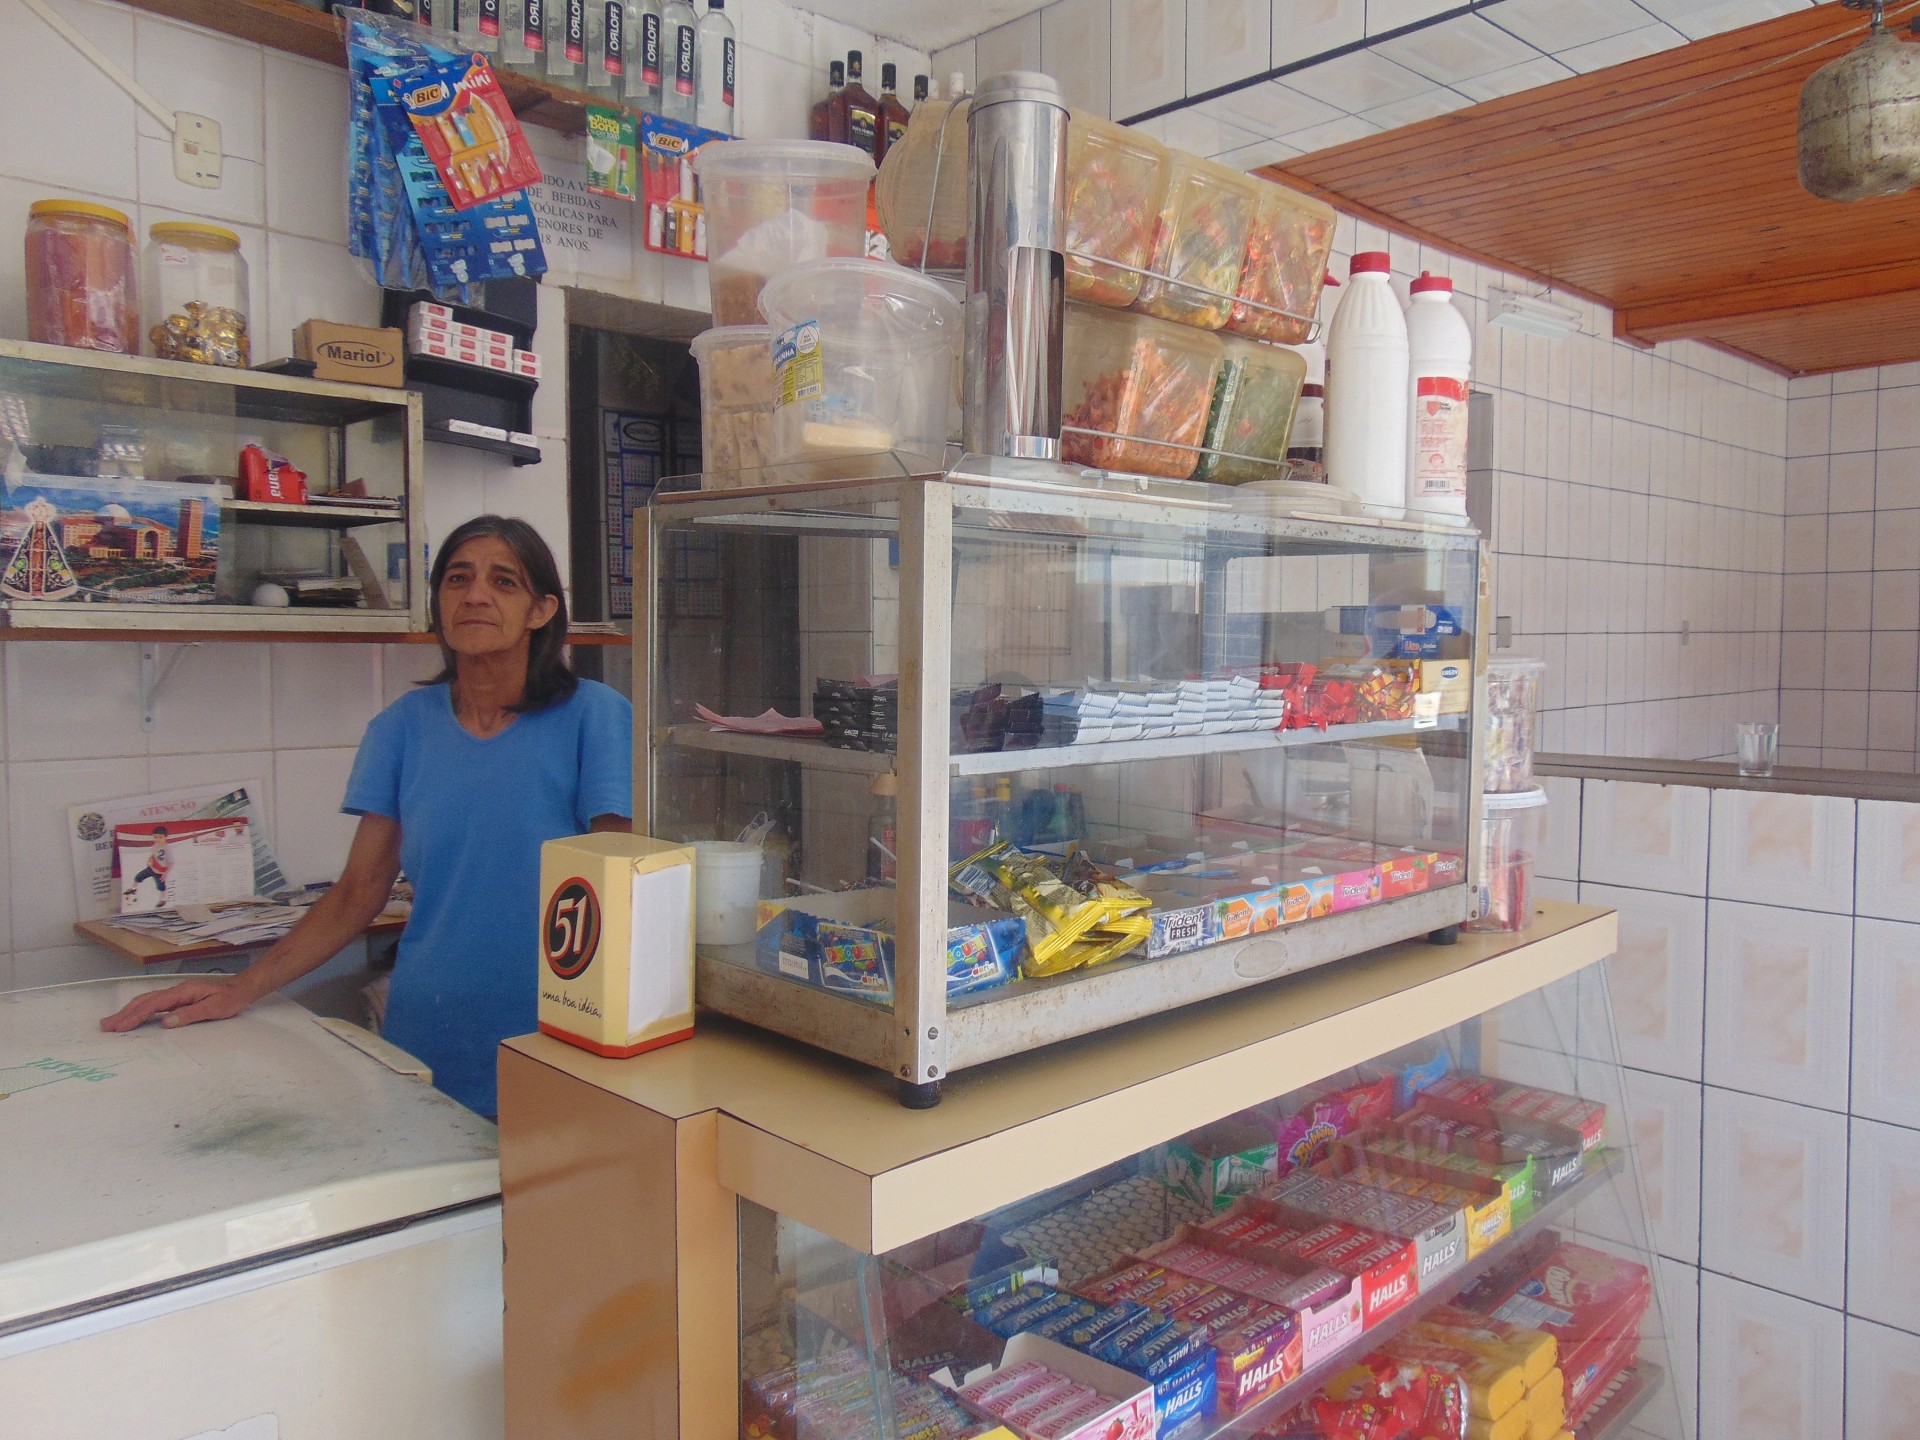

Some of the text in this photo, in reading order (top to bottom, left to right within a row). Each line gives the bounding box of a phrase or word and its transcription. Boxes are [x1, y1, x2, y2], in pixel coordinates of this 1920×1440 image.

[571, 0, 582, 38] ORLOF
[610, 6, 620, 51] ORLOFF
[647, 16, 659, 62] ORLOFF
[682, 28, 692, 73] ORLOFF
[453, 69, 491, 93] mini
[416, 88, 440, 103] BIC
[590, 115, 620, 134] Bond
[658, 137, 681, 149] BIC
[527, 185, 601, 210] DE BEBIDAS
[532, 200, 618, 229] OÓLICAS PARA
[536, 216, 583, 235] ENORES
[588, 227, 603, 239] DE
[541, 233, 551, 244] 18
[327, 345, 380, 363] Mariol
[551, 894, 588, 959] 51
[1163, 909, 1205, 931] Trident
[1171, 926, 1197, 939] FRESH
[542, 991, 561, 1003] uma
[562, 990, 577, 1009] boa
[1552, 1157, 1577, 1186] HALLS
[1510, 1181, 1526, 1200] LLS
[1218, 1215, 1254, 1236] HALL
[1297, 1224, 1343, 1249] HALLS
[1328, 1232, 1373, 1258] HALLS
[1356, 1240, 1404, 1267] HALLS
[1422, 1240, 1456, 1277] HALLS
[1101, 1268, 1149, 1291] HALLS
[1120, 1278, 1166, 1300] HALLS
[1154, 1282, 1200, 1310] HALLS
[1188, 1293, 1234, 1319] HALLS
[1369, 1274, 1408, 1313] HALLS
[1086, 1306, 1127, 1334] HALLS
[1209, 1305, 1250, 1330] HALLS
[1241, 1309, 1287, 1337] HALLS
[1115, 1319, 1154, 1348] HALLS
[1142, 1329, 1181, 1356] HALLS
[1308, 1313, 1349, 1351] HALLS
[1239, 1352, 1284, 1396] HALLS
[1165, 1380, 1203, 1419] HALLS
